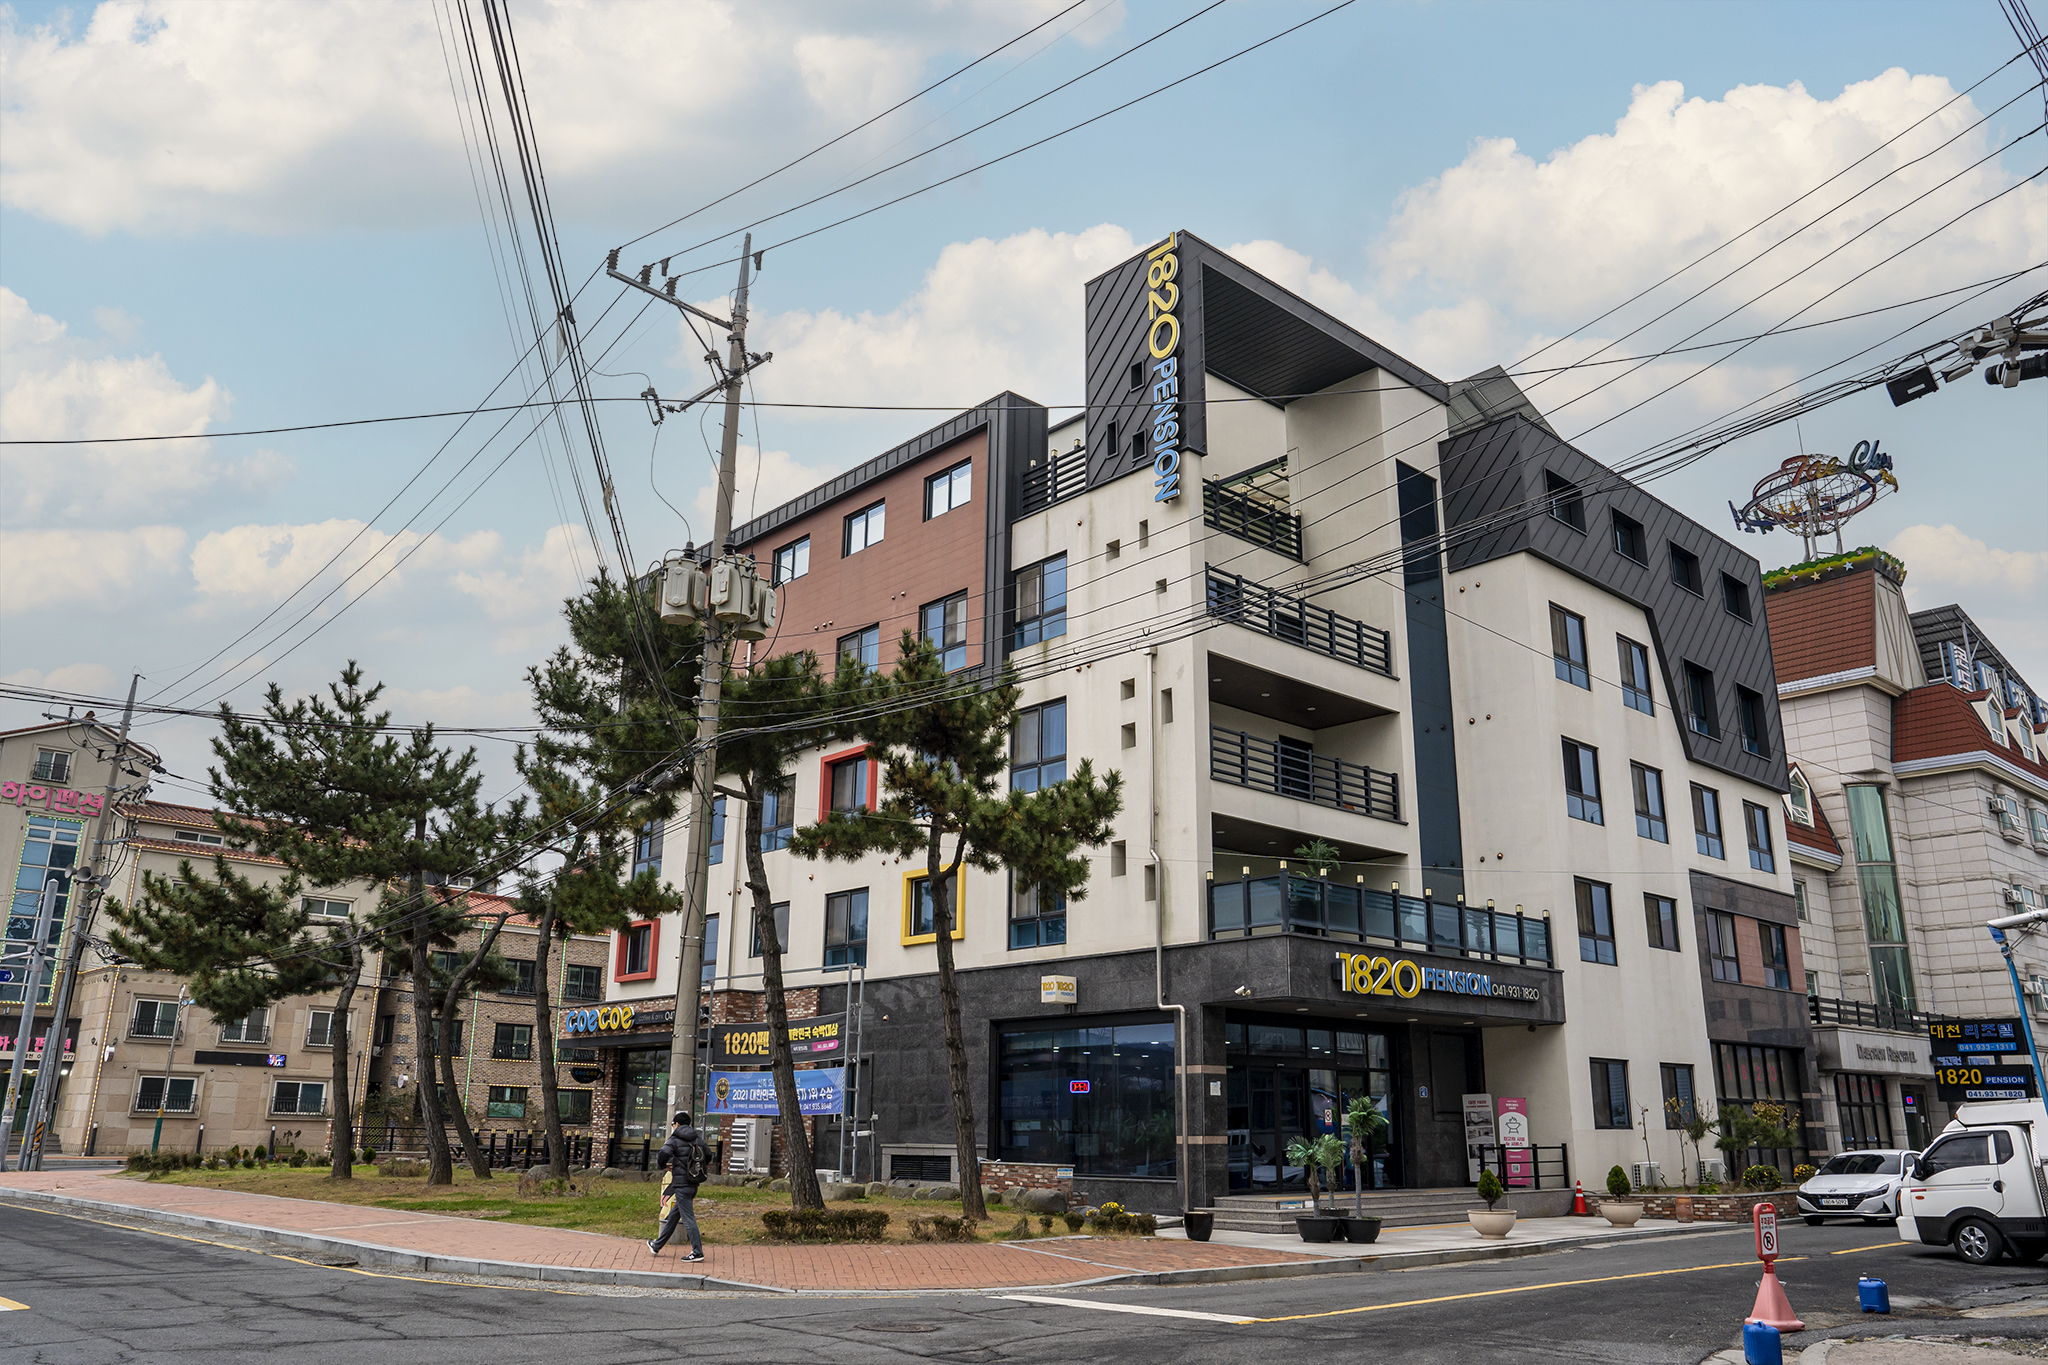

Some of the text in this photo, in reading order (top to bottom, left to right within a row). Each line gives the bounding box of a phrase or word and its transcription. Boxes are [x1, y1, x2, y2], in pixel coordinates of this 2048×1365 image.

[1148, 231, 1181, 502] 1820 PENSION
[1, 781, 104, 816] 하이펜션
[1338, 952, 1422, 999] 1820
[1422, 967, 1492, 997] PENSION
[1056, 981, 1075, 992] 1820
[1930, 1023, 2015, 1039] 대천 리조텔
[724, 1031, 770, 1055] 1820펜
[1960, 1043, 2014, 1051] 041.933-1311
[1936, 1068, 2025, 1085] 1820 PENSION
[732, 1089, 749, 1100] 2021
[819, 1086, 833, 1100] 수상
[1072, 1081, 1089, 1092] OPEN
[1968, 1090, 2023, 1098] 041.931-1820
